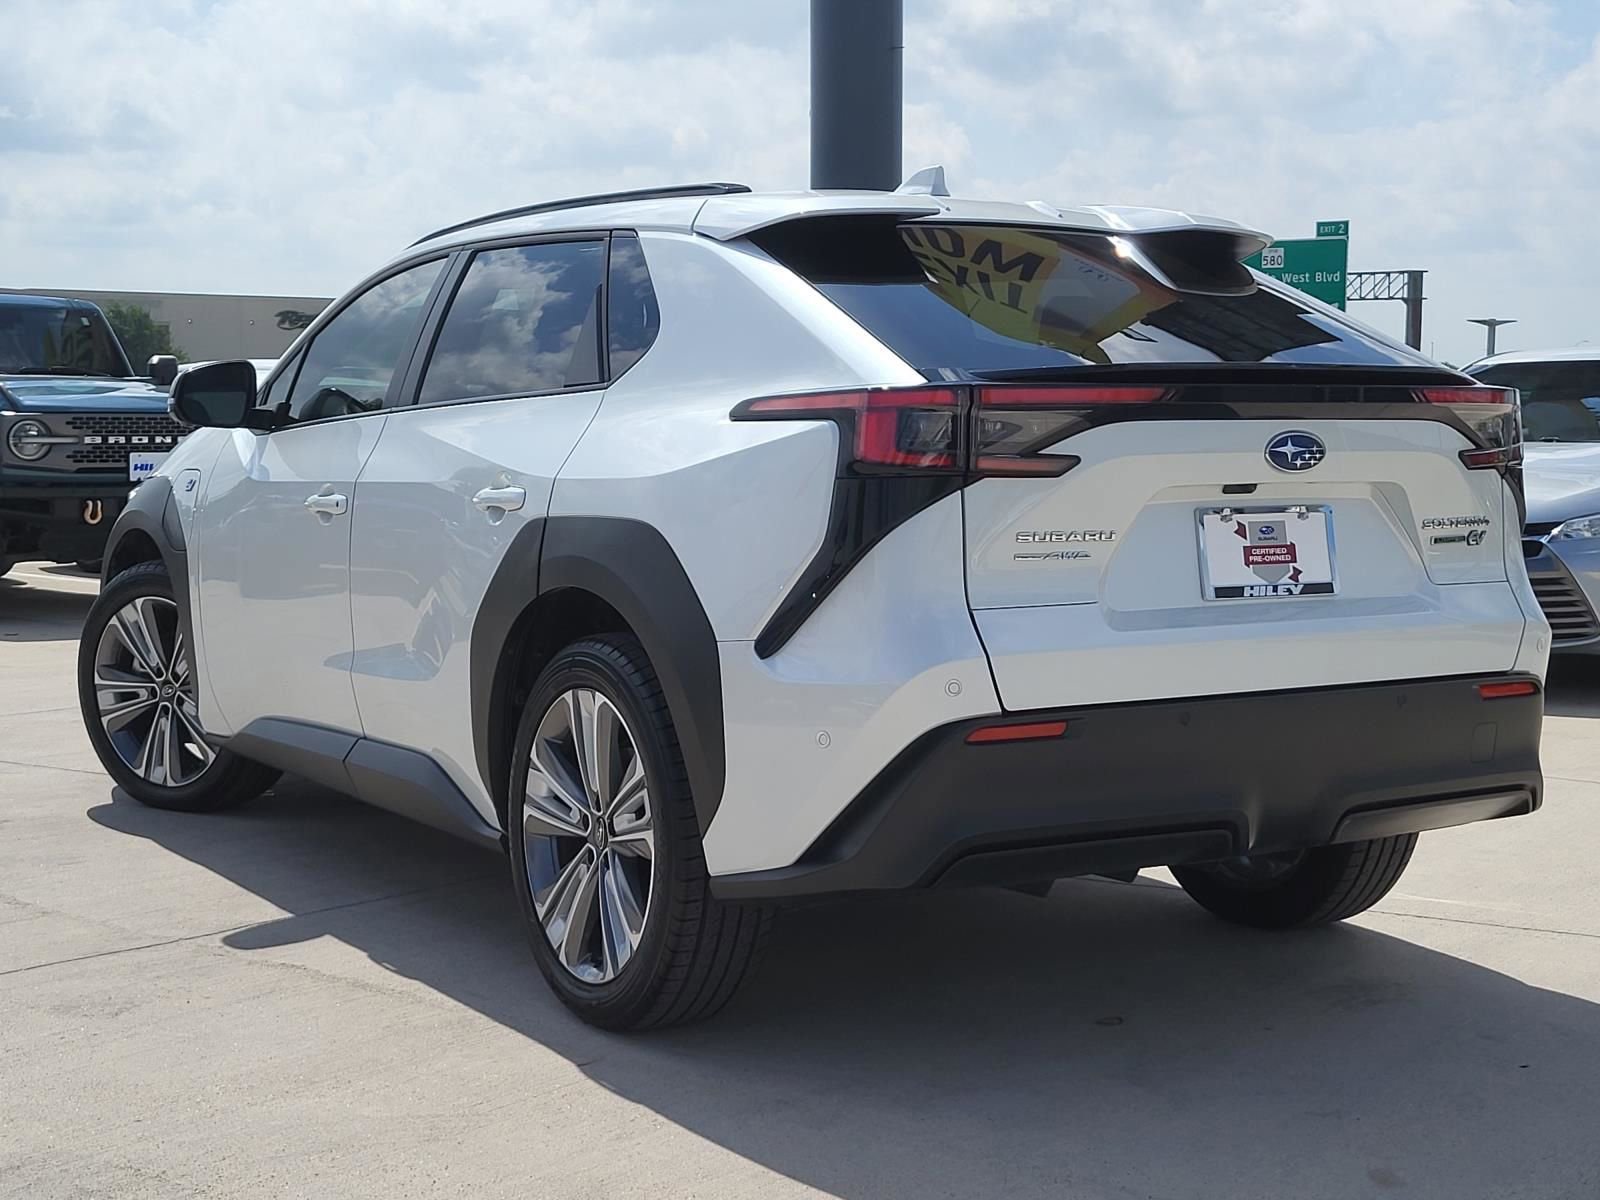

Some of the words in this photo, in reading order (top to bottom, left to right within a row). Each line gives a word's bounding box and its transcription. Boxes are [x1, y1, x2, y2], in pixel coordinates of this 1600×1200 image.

[1319, 225, 1335, 234] EXIT
[1338, 224, 1345, 234] 2
[1262, 254, 1283, 266] 580
[1281, 272, 1310, 283] West
[1315, 270, 1341, 283] Blvd
[1015, 530, 1117, 543] SUBARU
[1466, 529, 1487, 546] EV
[1251, 547, 1288, 555] CERTIFIED
[1249, 554, 1292, 563] PRE-OWNED
[1243, 584, 1305, 597] HILEY
